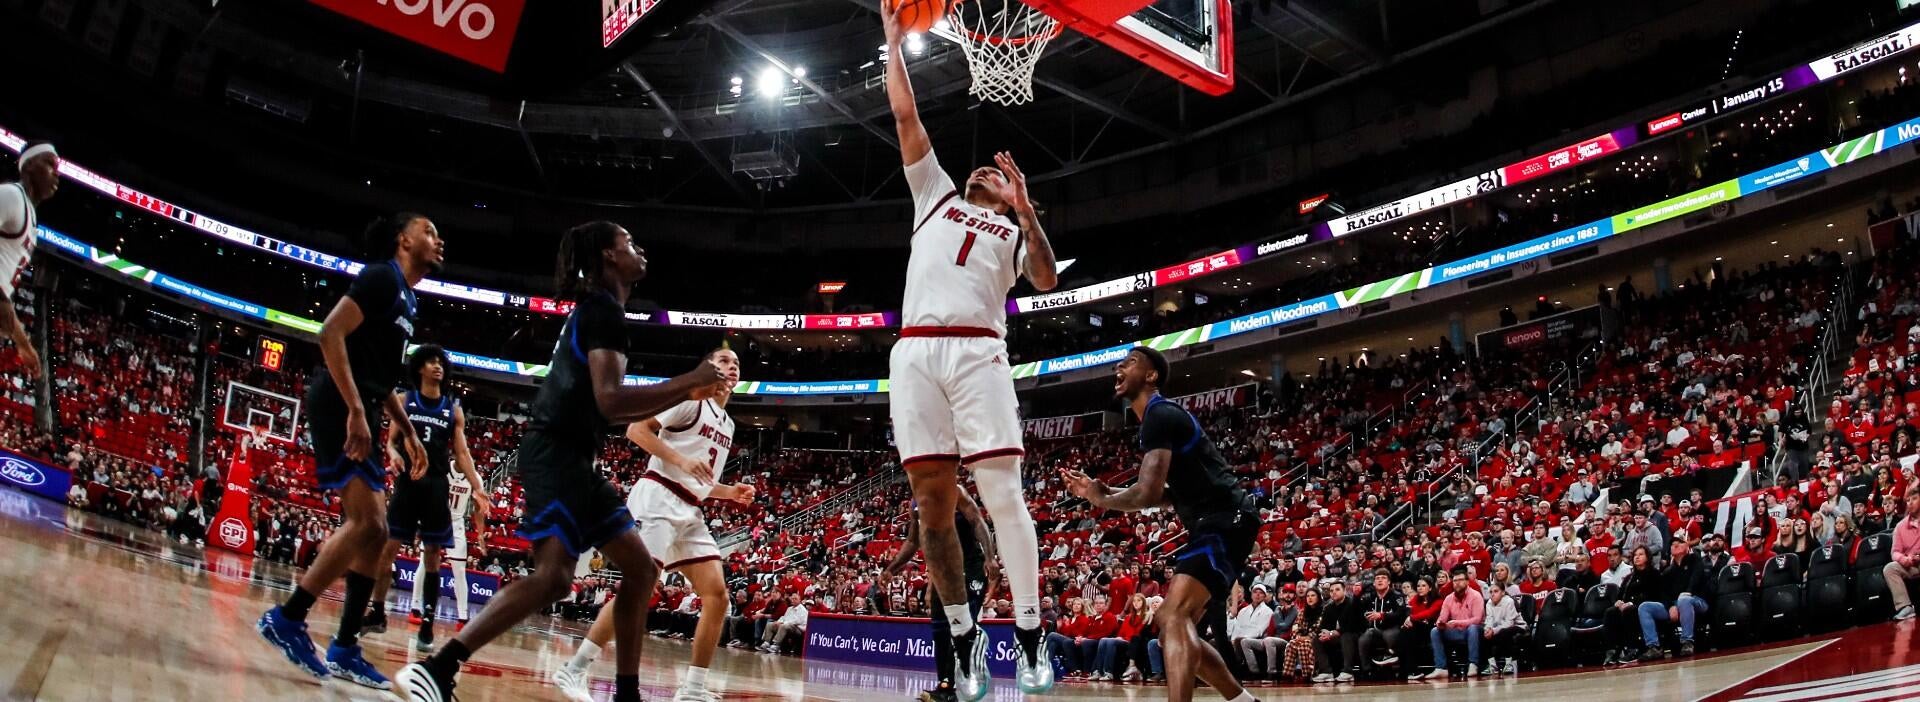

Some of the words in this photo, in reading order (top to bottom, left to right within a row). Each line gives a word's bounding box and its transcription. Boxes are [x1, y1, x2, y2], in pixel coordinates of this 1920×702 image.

[1834, 40, 1904, 73] RASCAL
[1650, 117, 1679, 131] Lenovo
[1682, 107, 1707, 120] Center
[1722, 86, 1766, 109] January
[1768, 77, 1784, 92] 15
[1346, 207, 1403, 231] RASCAL
[1407, 184, 1472, 214] FLATTS
[942, 206, 968, 224] NC
[965, 218, 1013, 242] STATE
[46, 230, 85, 254] Woodmen
[955, 231, 977, 267] 1
[1257, 233, 1308, 255] ticketmaster
[1443, 257, 1490, 278] Pioneering
[1491, 252, 1506, 265] life
[1507, 242, 1551, 260] insurance
[1551, 235, 1575, 248] since
[1576, 226, 1598, 240] 1883
[1032, 296, 1078, 310] RASCAL
[682, 316, 727, 326] RASCAL
[1230, 316, 1271, 333] Modern
[1271, 301, 1327, 323] Woodmen
[1507, 330, 1541, 344] Lenovo
[467, 355, 510, 371] Woodmen
[1048, 358, 1082, 372] Modern
[1083, 348, 1128, 365] Woodmen
[409, 414, 449, 428] ASHEVILLE
[698, 423, 715, 439] NC
[1025, 415, 1075, 438] ENGTH
[423, 426, 432, 442] 3
[2, 460, 36, 482] Ford
[235, 484, 249, 495] PNC
[222, 526, 244, 540] CPI
[472, 583, 493, 597] Son
[810, 632, 818, 646] If
[819, 634, 833, 648] You
[834, 635, 859, 652] Can't,
[862, 637, 877, 652] We
[878, 638, 901, 654] Can!
